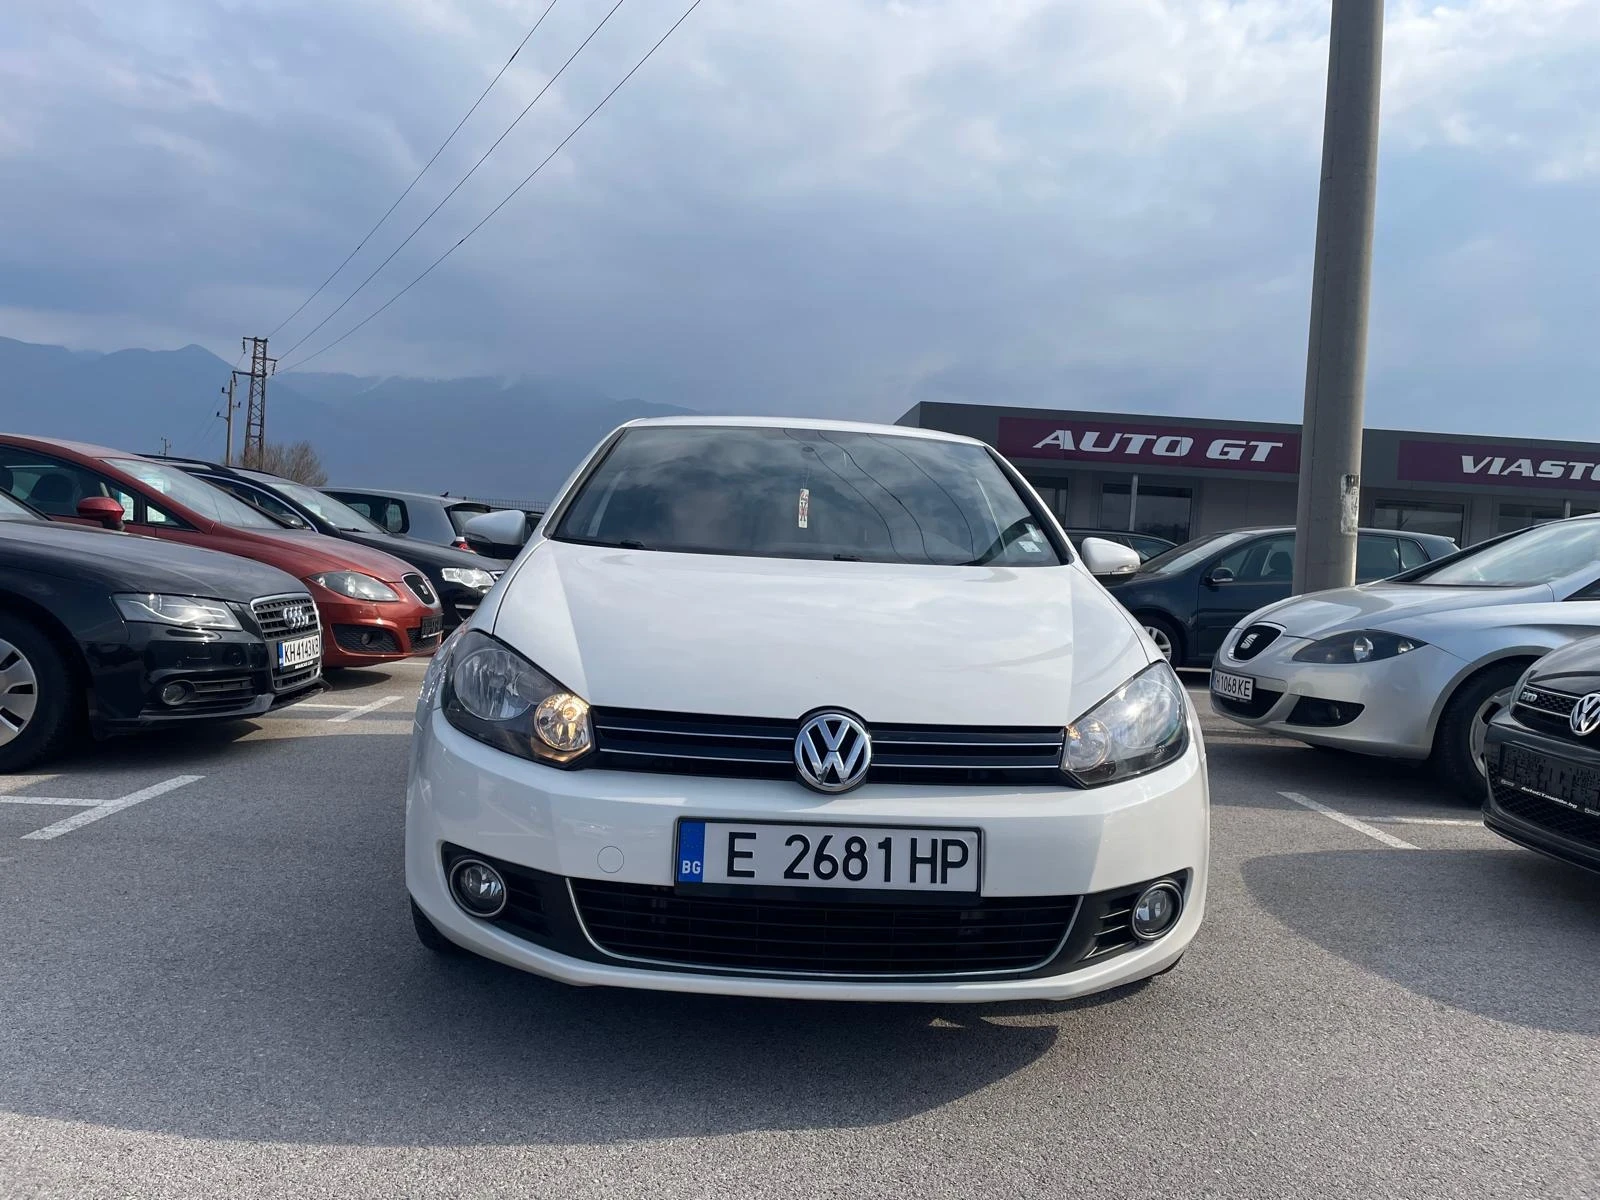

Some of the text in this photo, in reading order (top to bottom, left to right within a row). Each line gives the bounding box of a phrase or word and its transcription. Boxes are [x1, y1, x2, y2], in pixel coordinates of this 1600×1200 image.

[1032, 430, 1283, 462] AUTO GT
[681, 859, 702, 875] BG
[726, 831, 757, 878] E
